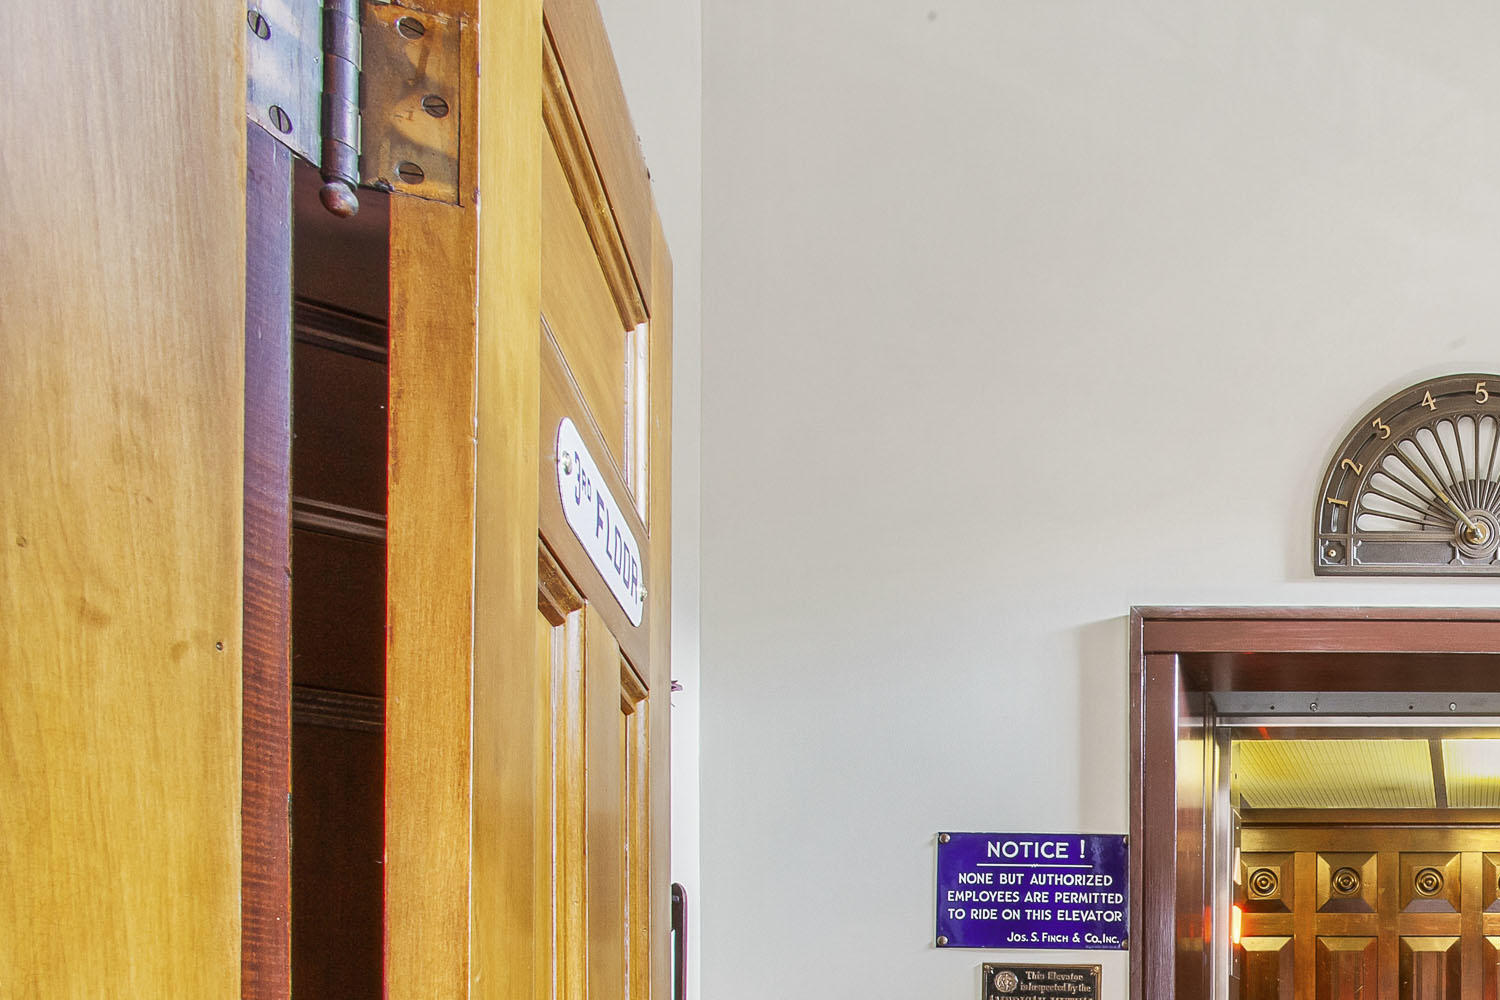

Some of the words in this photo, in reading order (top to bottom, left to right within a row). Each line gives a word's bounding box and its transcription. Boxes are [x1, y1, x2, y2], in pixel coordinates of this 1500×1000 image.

[1327, 496, 1349, 508] 1
[1341, 457, 1364, 476] 2
[1372, 417, 1391, 440] 3
[1420, 390, 1437, 411] 4
[1475, 382, 1489, 404] 5
[596, 489, 639, 605] FLOOR
[987, 840, 1070, 859] NOTICE
[1079, 839, 1086, 859] !
[958, 872, 994, 885] NONE
[1000, 873, 1025, 885] BUT
[1029, 874, 1113, 886] AUTHORIZED
[947, 890, 1020, 903] EMPLOYEES
[1023, 891, 1049, 903] ARE
[1054, 892, 1124, 904] PERMITTED
[947, 908, 966, 920] TO
[970, 908, 998, 920] RIDE
[1001, 908, 1021, 920] ON
[1025, 909, 1052, 921] THIS
[1057, 909, 1123, 922] ELEVATOR
[1030, 932, 1040, 943] S.
[1072, 932, 1081, 943] &
[1047, 971, 1084, 981] Elevator
[1078, 983, 1091, 992] the
